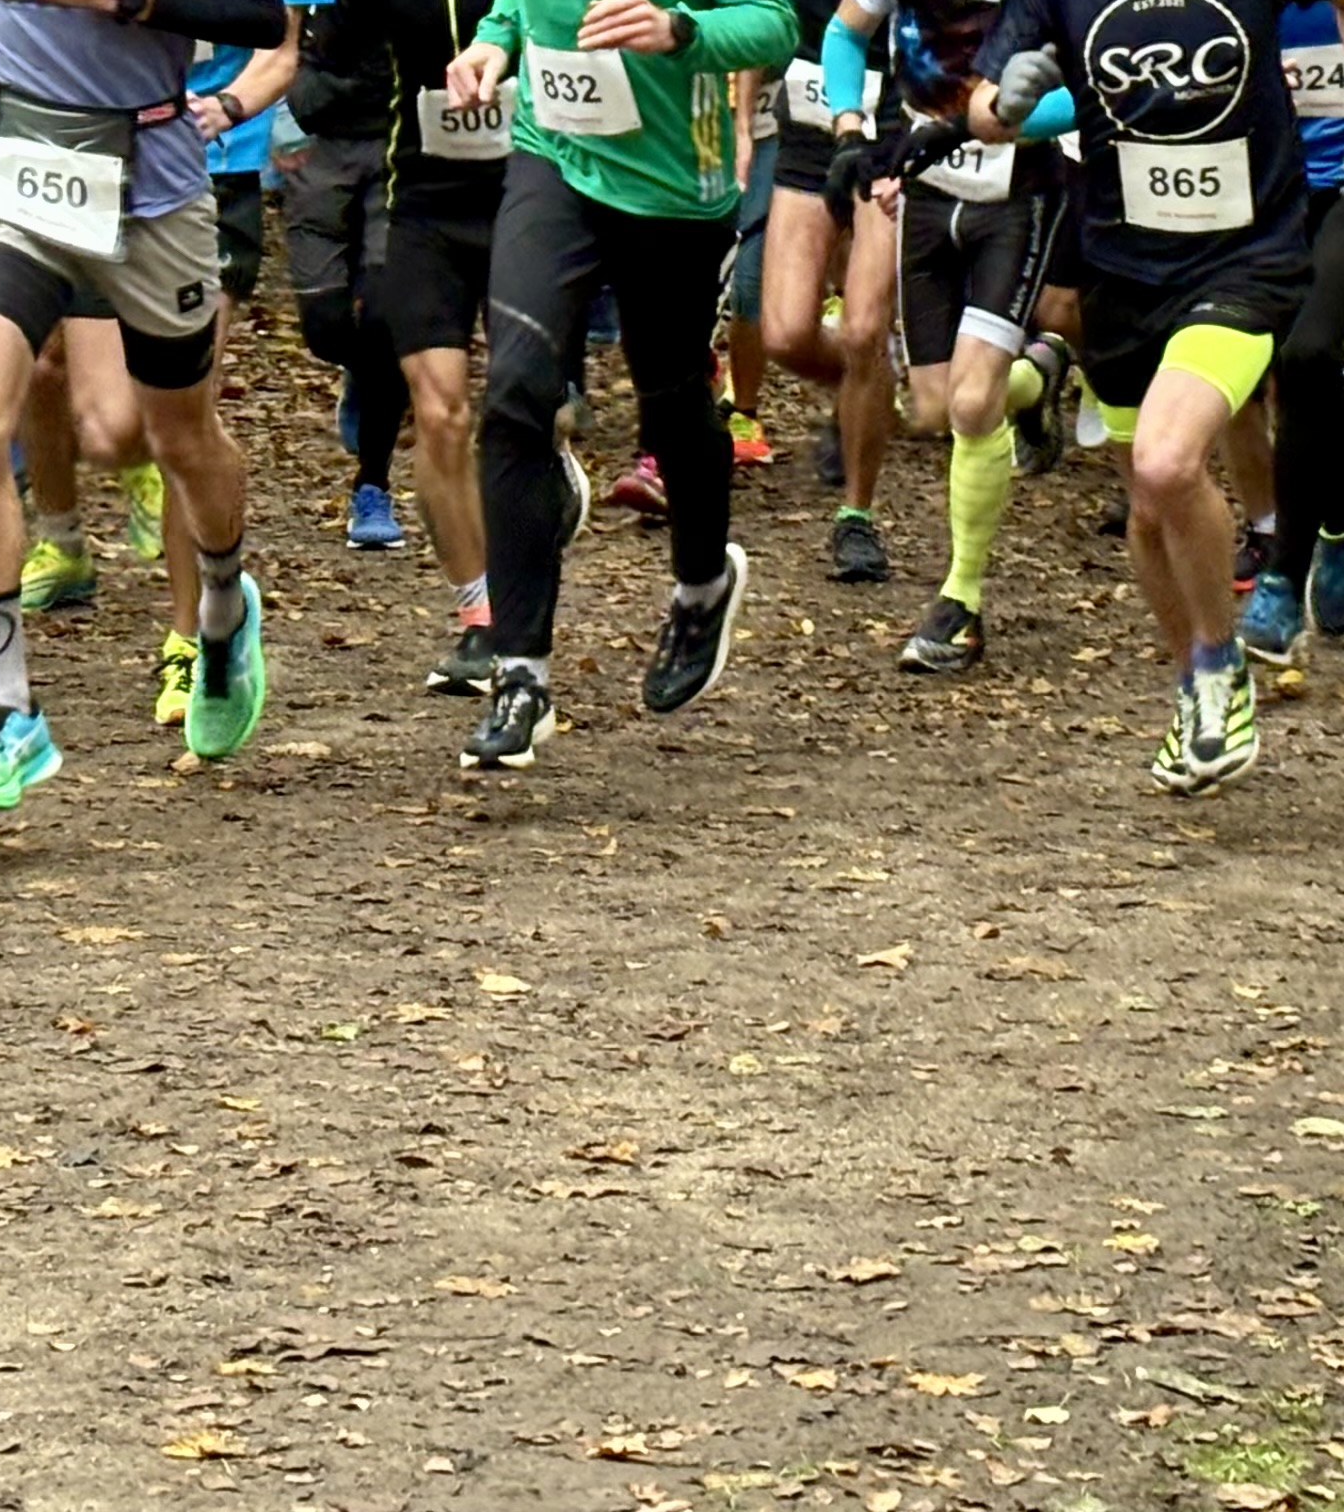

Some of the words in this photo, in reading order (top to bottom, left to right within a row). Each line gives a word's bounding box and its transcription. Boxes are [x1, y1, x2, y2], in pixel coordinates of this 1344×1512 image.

[1097, 37, 1238, 94] SRC
[541, 69, 602, 103] 832
[440, 102, 503, 133] 500
[17, 166, 88, 208] 650
[1149, 166, 1221, 198] 865
